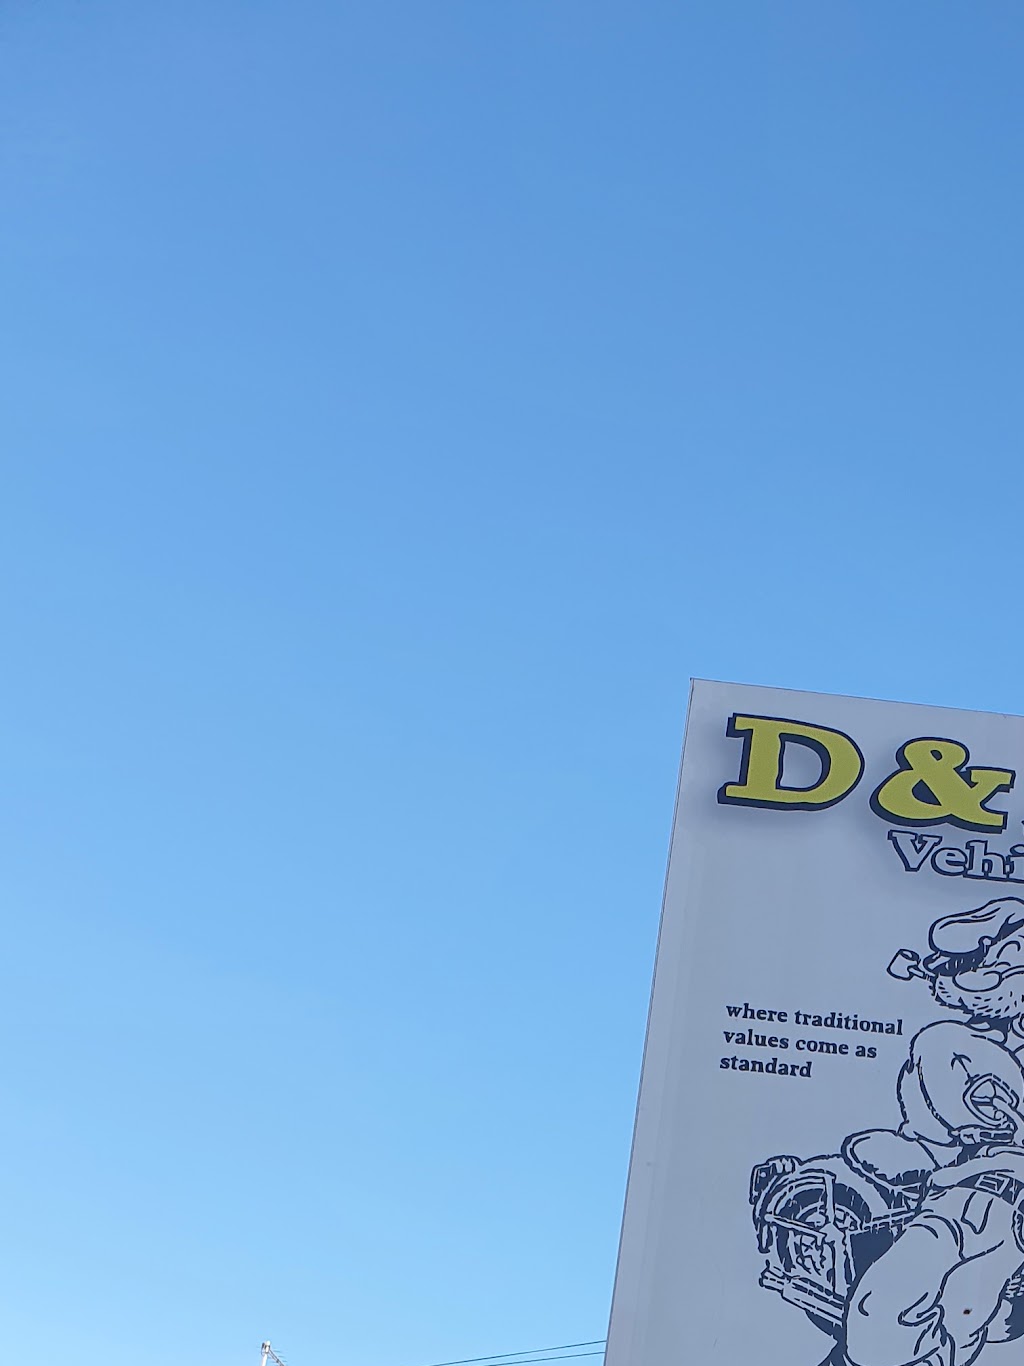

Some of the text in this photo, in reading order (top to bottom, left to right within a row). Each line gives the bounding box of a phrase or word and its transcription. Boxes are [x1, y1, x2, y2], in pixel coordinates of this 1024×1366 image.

[726, 1002, 903, 1036] where traditional
[723, 1028, 877, 1059] values come as
[719, 1055, 812, 1078] standard
